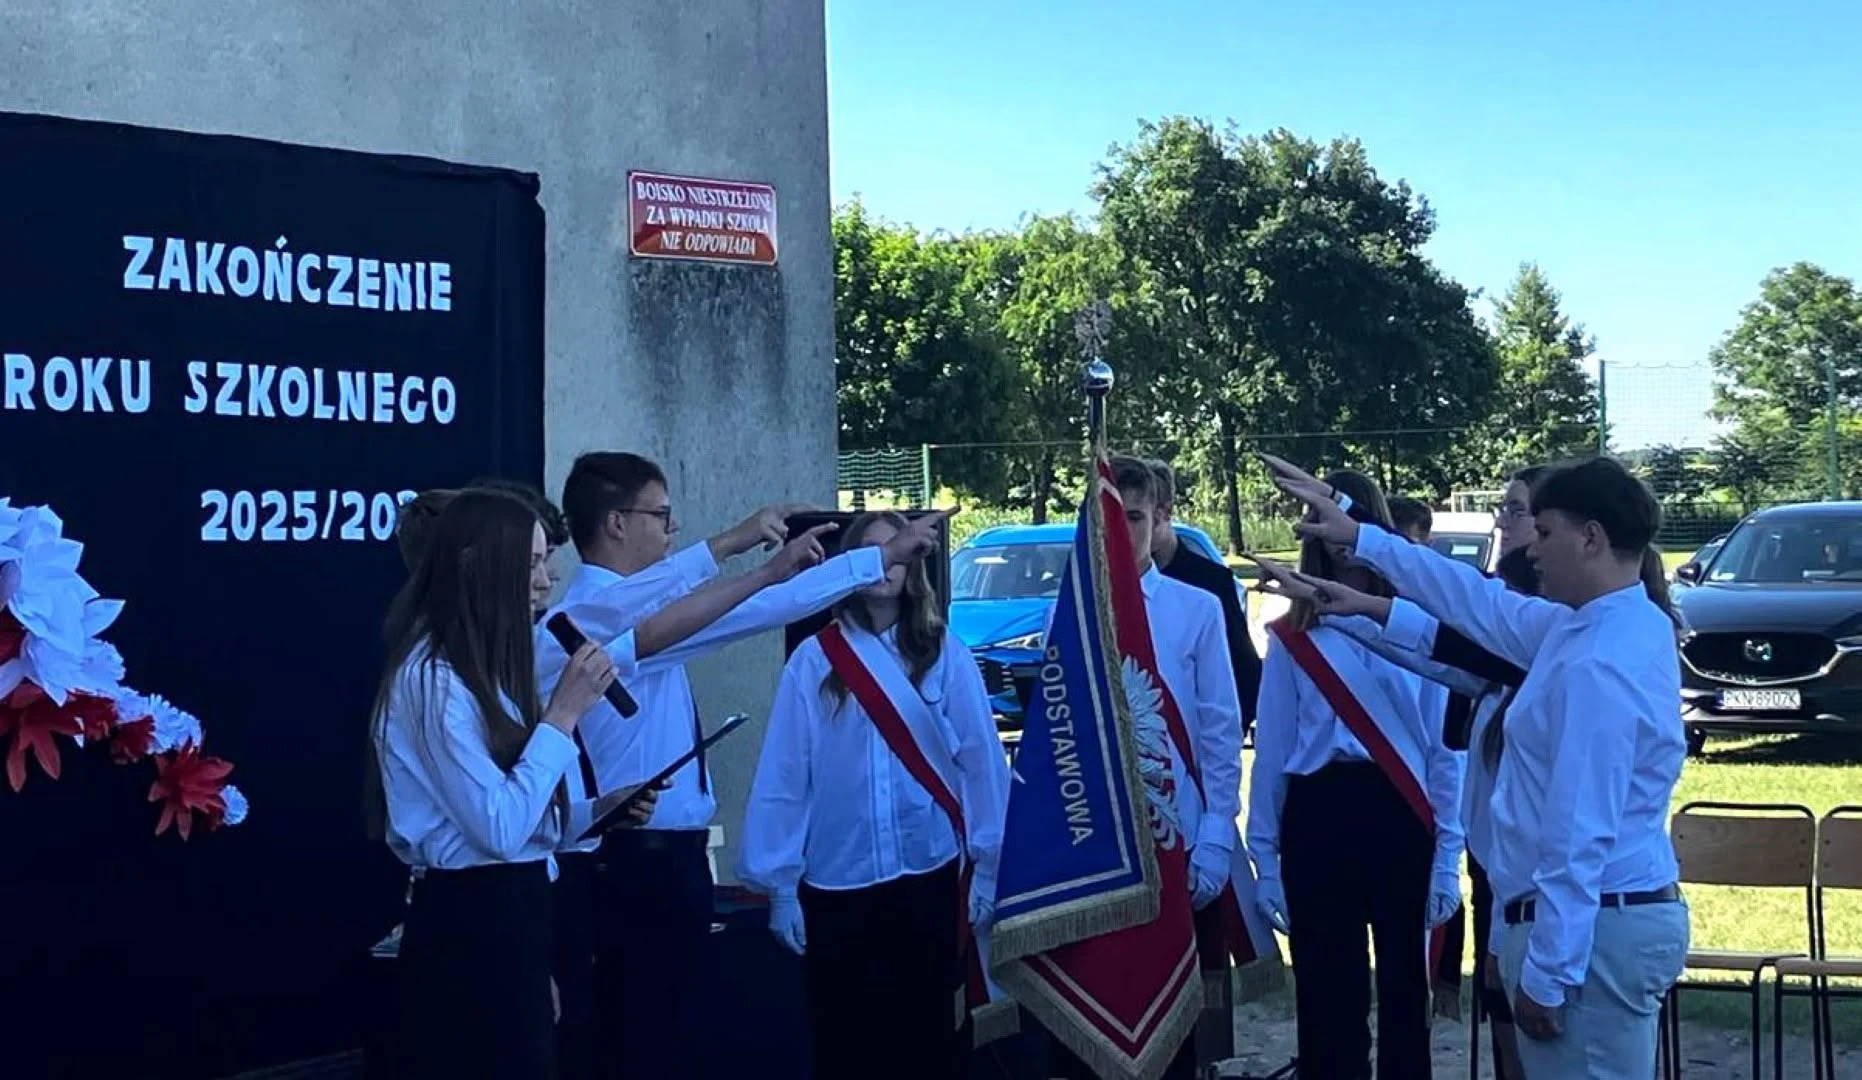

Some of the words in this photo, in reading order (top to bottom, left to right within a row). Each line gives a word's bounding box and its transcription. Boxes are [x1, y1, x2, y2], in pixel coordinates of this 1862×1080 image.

[637, 181, 685, 202] BOISKO
[646, 206, 665, 225] ZA
[671, 207, 723, 230] WYPADKI
[660, 231, 683, 250] NIE
[685, 233, 756, 256] ODPOWIADA
[122, 235, 452, 312] ZAKOŃCZENIE
[3, 353, 151, 413] ROKU
[184, 361, 457, 425] SZKOLNEGO
